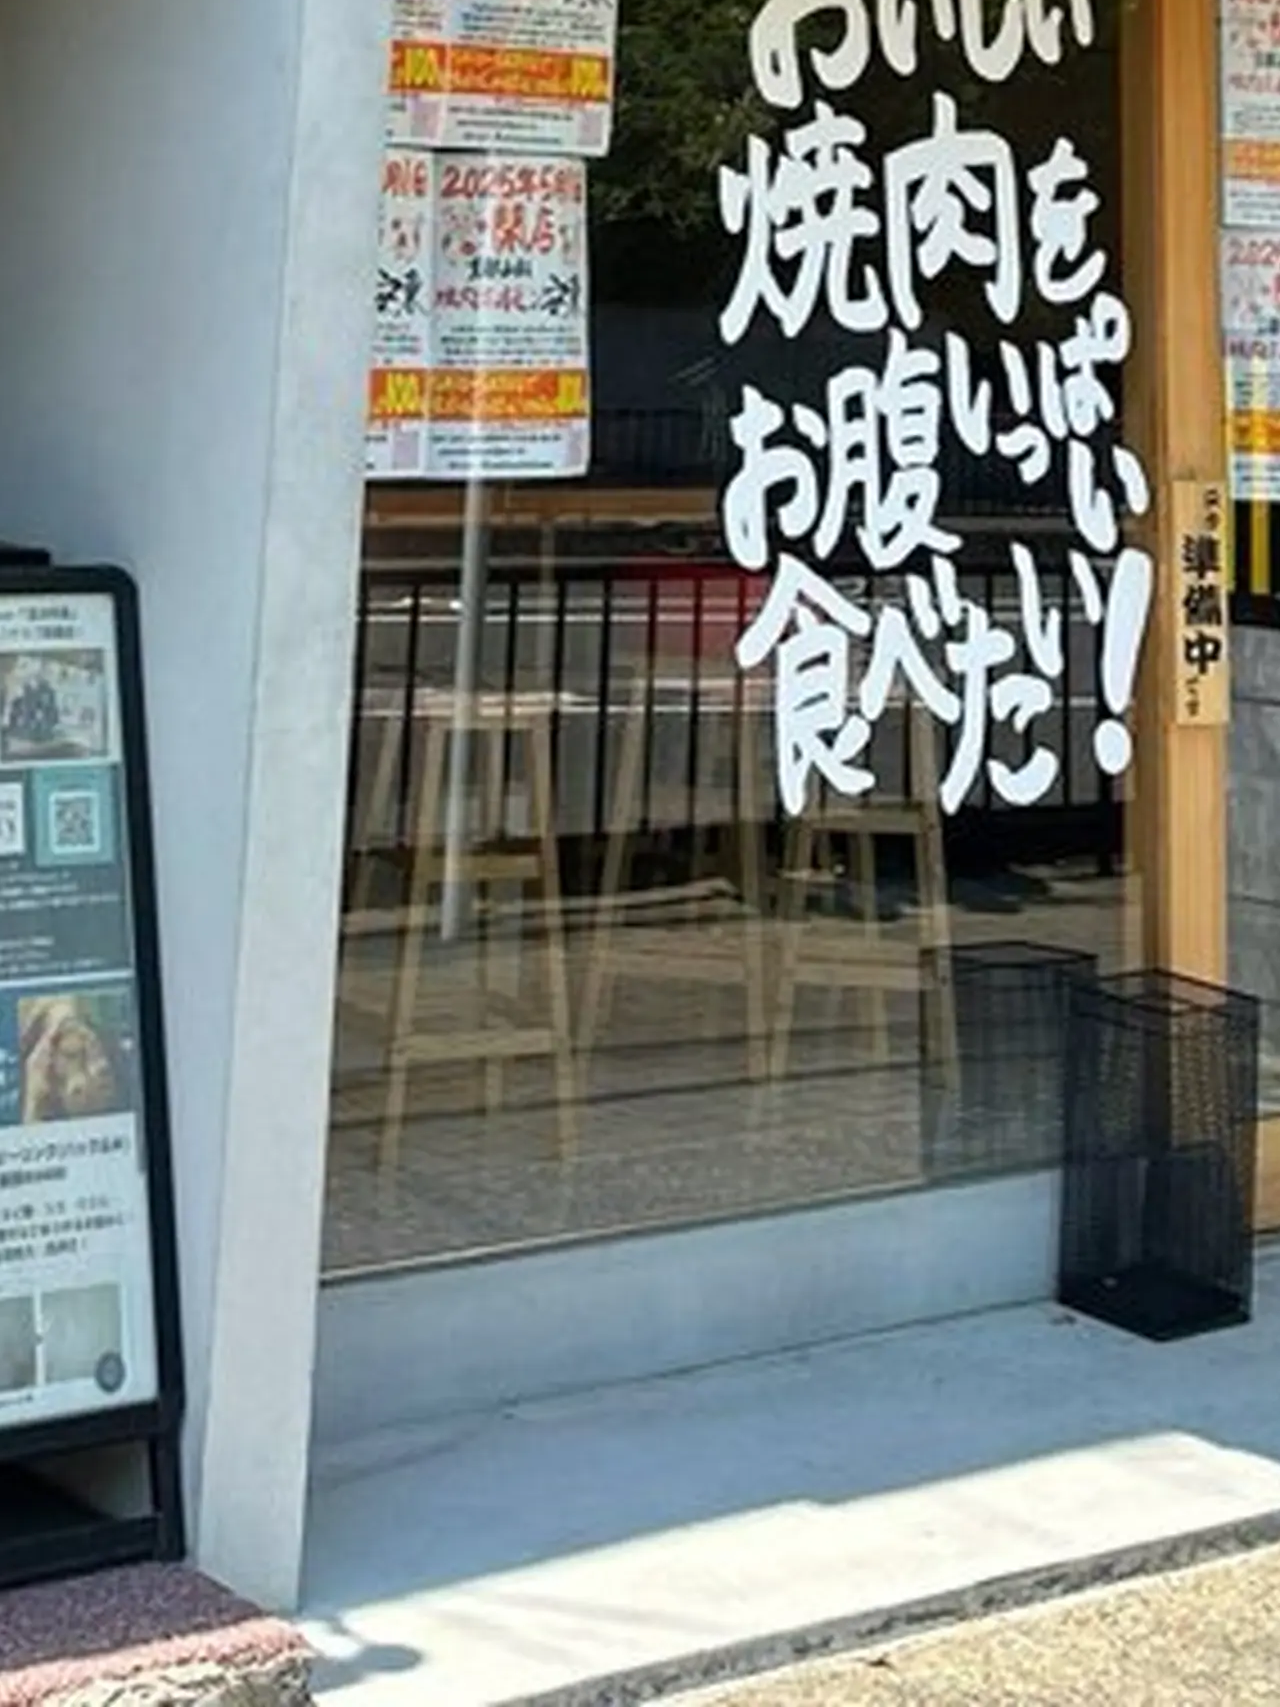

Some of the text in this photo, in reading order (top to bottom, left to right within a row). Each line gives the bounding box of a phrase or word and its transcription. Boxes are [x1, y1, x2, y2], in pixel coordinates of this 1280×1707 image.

[720, 90, 1108, 346] 焼肉を
[723, 291, 1151, 575] お腹いっぱい
[735, 537, 1155, 817] 食べたい!
[1182, 533, 1222, 676] 準備中
